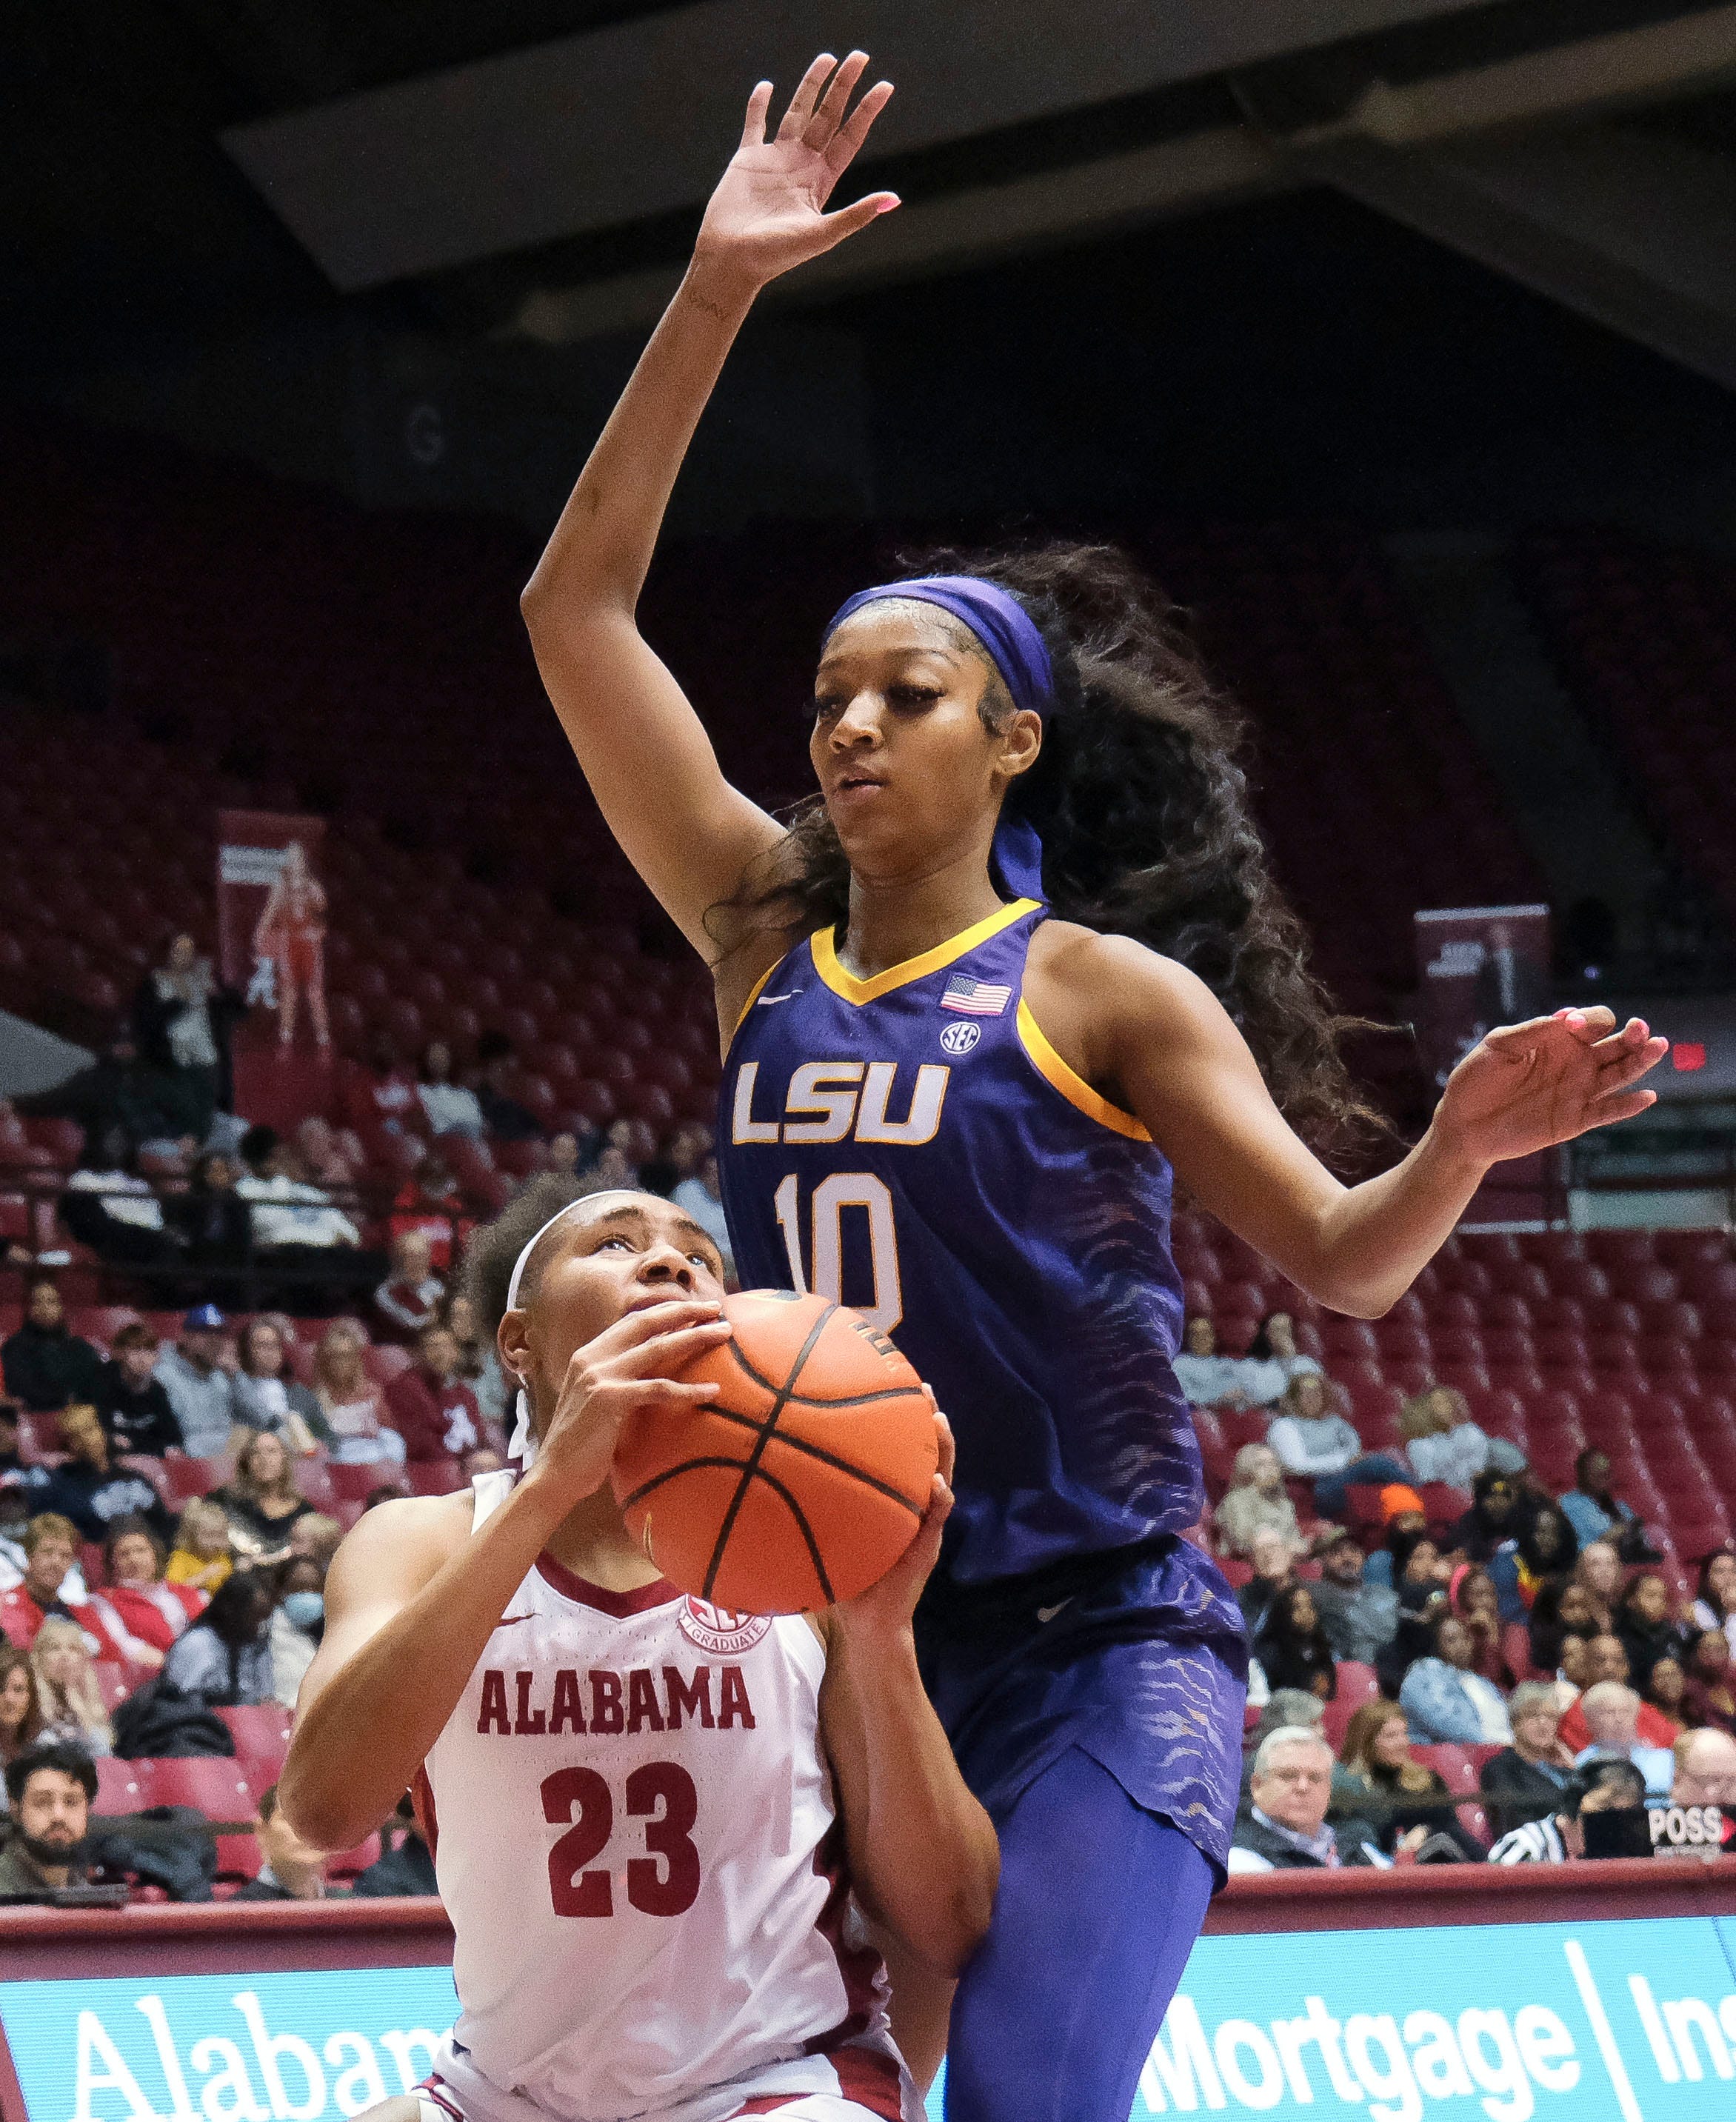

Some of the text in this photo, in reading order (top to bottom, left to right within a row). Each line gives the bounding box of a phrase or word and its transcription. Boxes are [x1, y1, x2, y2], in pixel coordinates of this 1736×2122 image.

[942, 1024, 978, 1052] SEC
[732, 1061, 950, 1144] LSU
[774, 1172, 904, 1334] 10
[692, 1624, 764, 1651] GRADUATE
[476, 1666, 756, 1735] ALABAMA
[540, 1761, 701, 1918] 23
[1649, 1806, 1723, 1845] POSS
[1138, 1994, 1581, 2122] Mortgage
